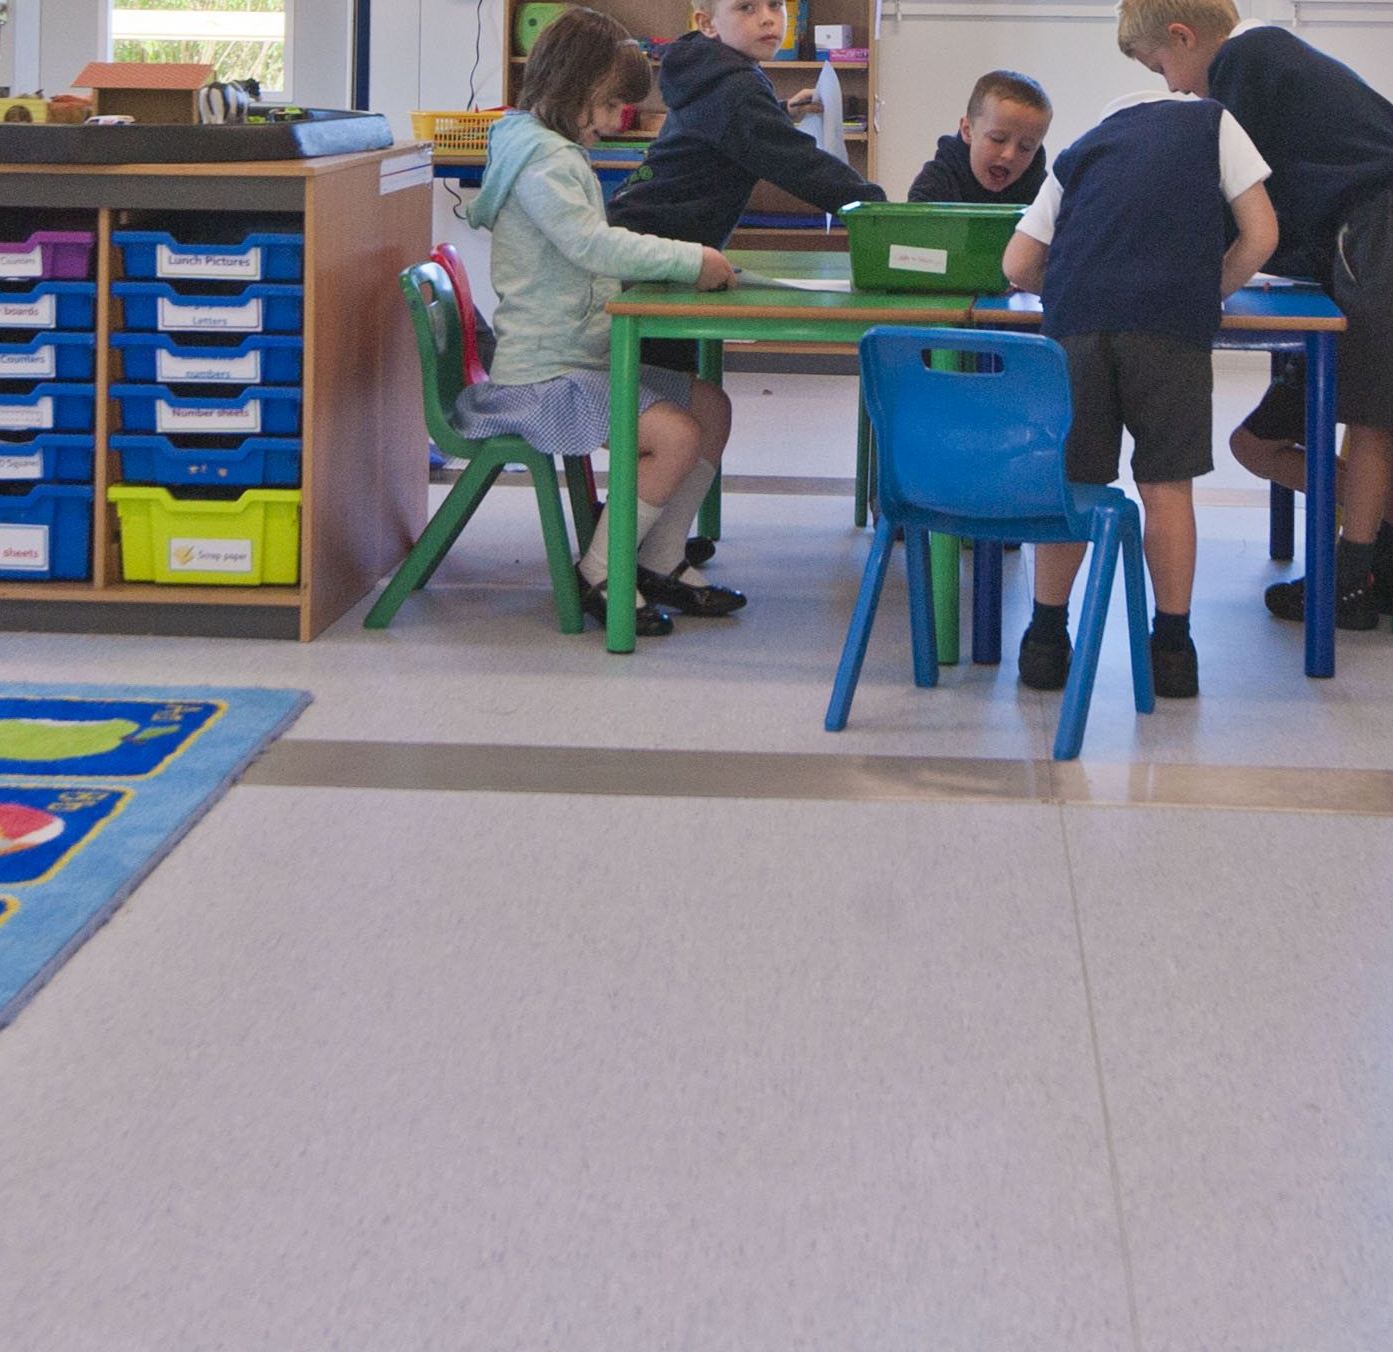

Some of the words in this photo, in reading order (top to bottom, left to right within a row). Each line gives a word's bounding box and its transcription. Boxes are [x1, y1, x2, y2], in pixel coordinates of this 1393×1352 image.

[168, 256, 203, 266] Lunch
[206, 257, 251, 267] Pictures
[5, 304, 40, 316] boards
[193, 316, 228, 326] Letters
[0, 356, 46, 365] Counters
[186, 369, 231, 380] numbers
[172, 409, 214, 418] Number
[217, 409, 249, 418] sheets
[3, 547, 39, 559] sheets
[223, 552, 247, 564] paper
[49, 792, 110, 813] Bb
